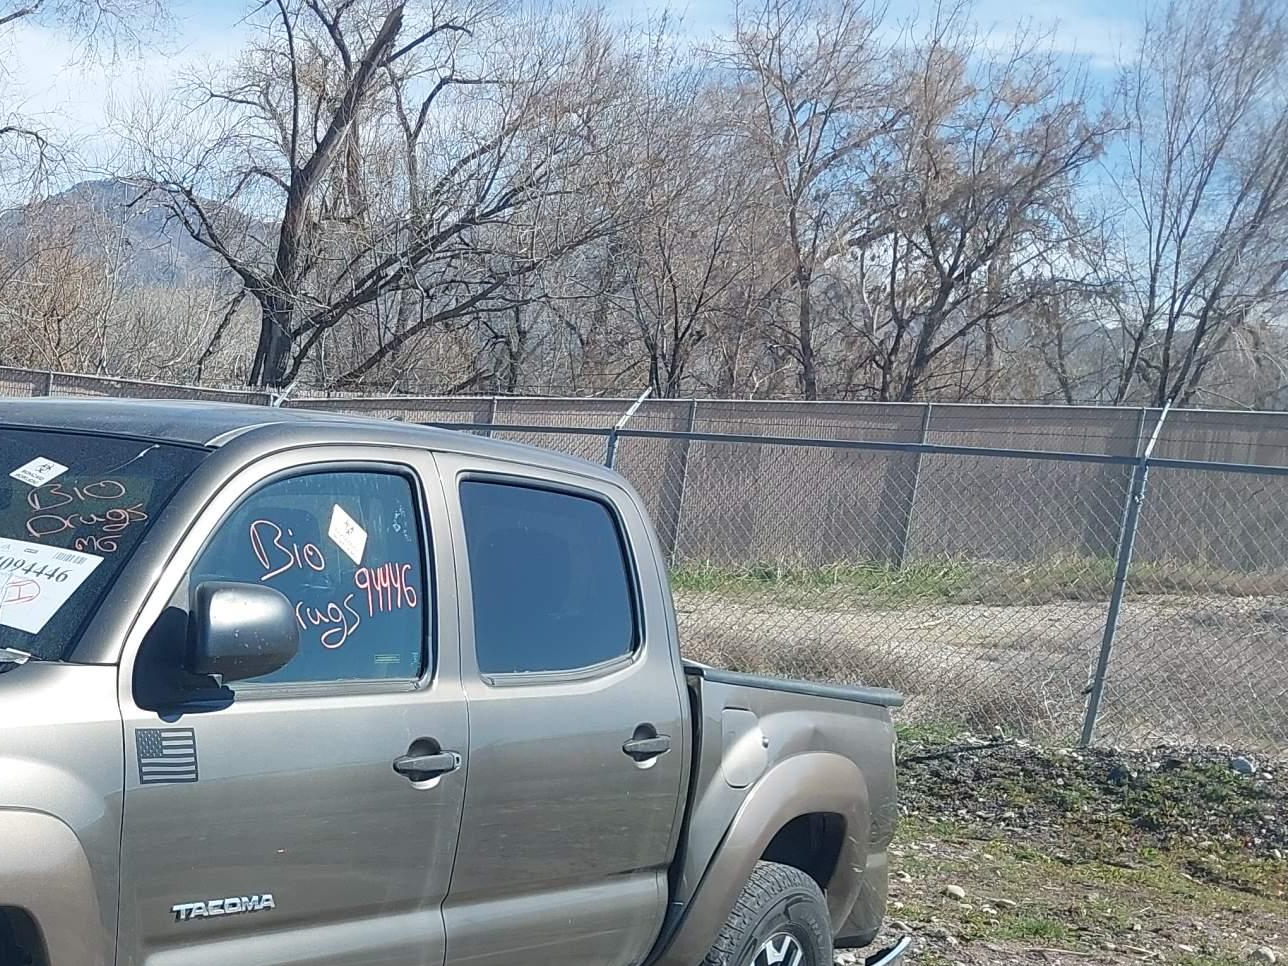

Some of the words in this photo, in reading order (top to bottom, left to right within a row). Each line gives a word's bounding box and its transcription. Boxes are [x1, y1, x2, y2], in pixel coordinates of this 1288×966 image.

[354, 562, 417, 618] 94446
[295, 594, 361, 649] rugs
[171, 893, 276, 921] TACOMA
